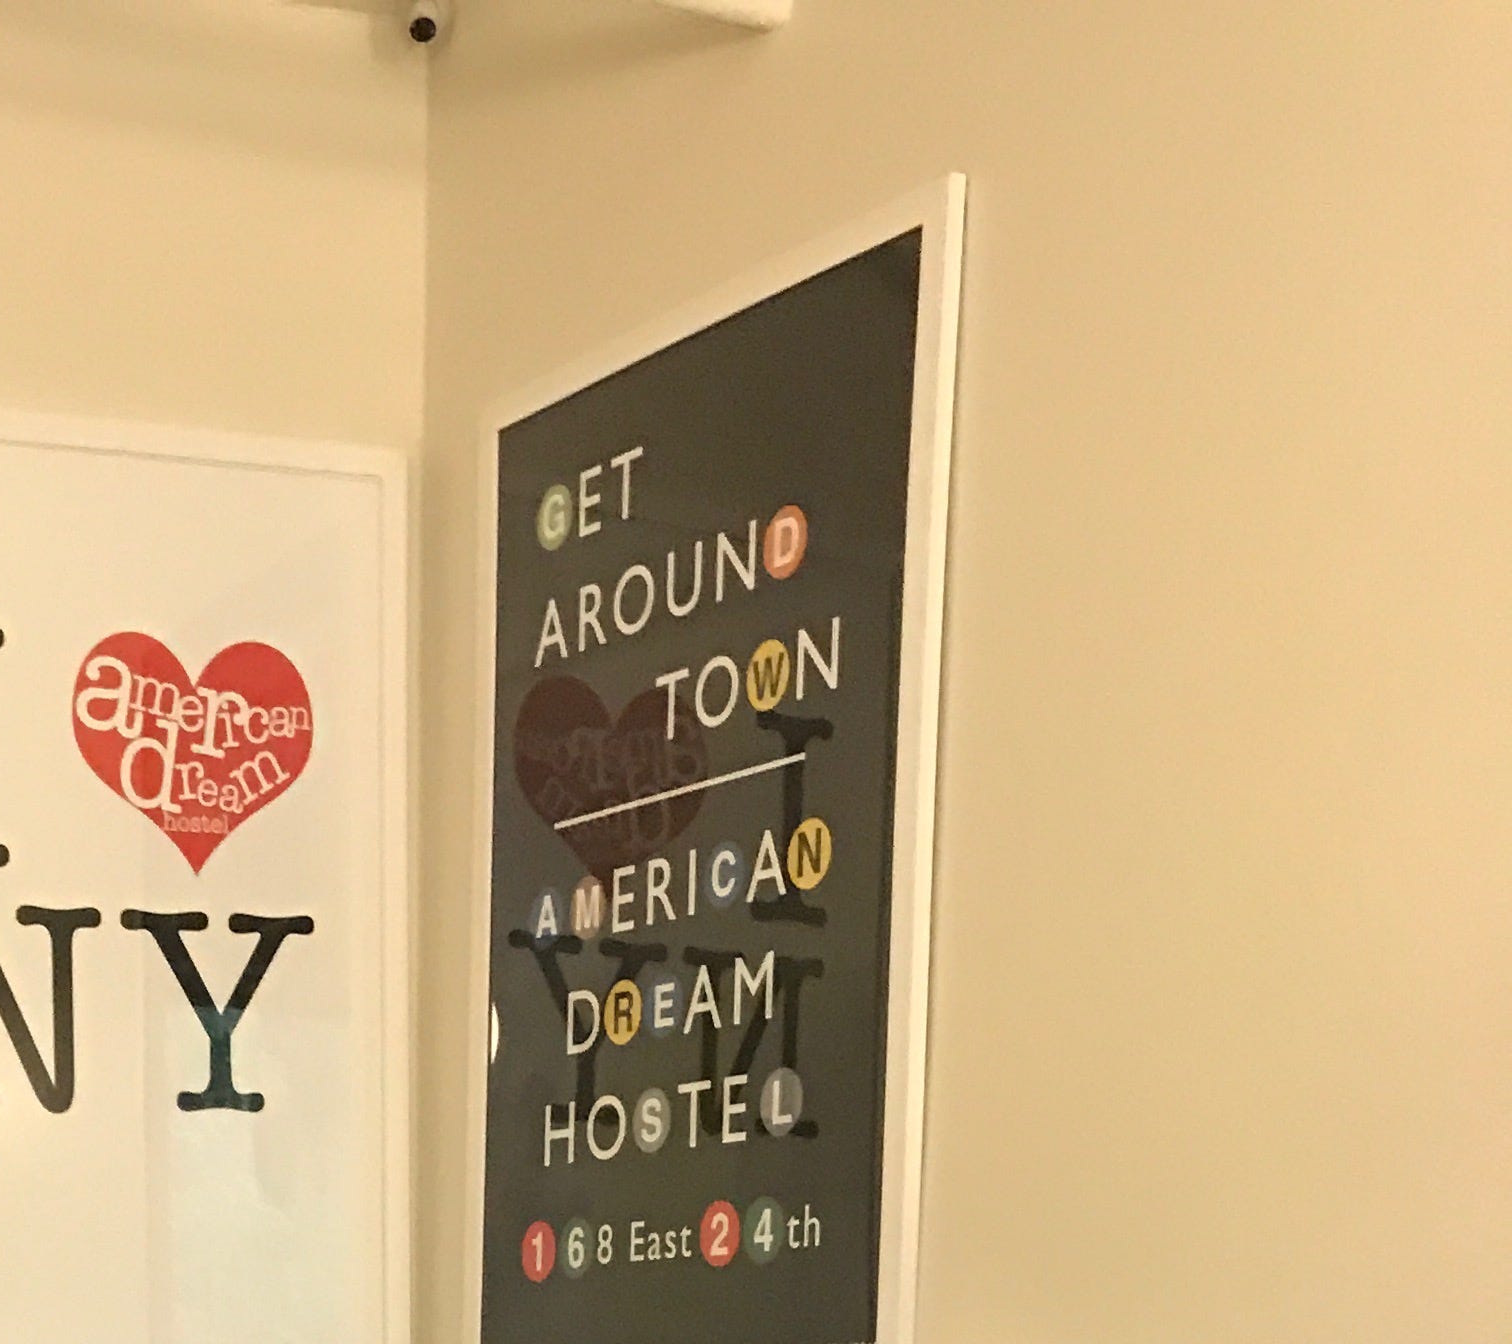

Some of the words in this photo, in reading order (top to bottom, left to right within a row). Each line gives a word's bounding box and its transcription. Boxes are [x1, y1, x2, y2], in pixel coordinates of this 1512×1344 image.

[541, 446, 643, 542] GET
[534, 516, 802, 668] AROUND
[76, 656, 311, 758] american
[655, 616, 841, 741] TOWN
[120, 719, 290, 813] dream
[163, 812, 229, 835] hostel
[535, 826, 823, 940] AMERICAN
[566, 950, 775, 1055] DREAM
[543, 1074, 794, 1167] HOSTEL
[530, 1222, 615, 1273] 168
[629, 1220, 693, 1263] East
[708, 1204, 821, 1259] 24th
